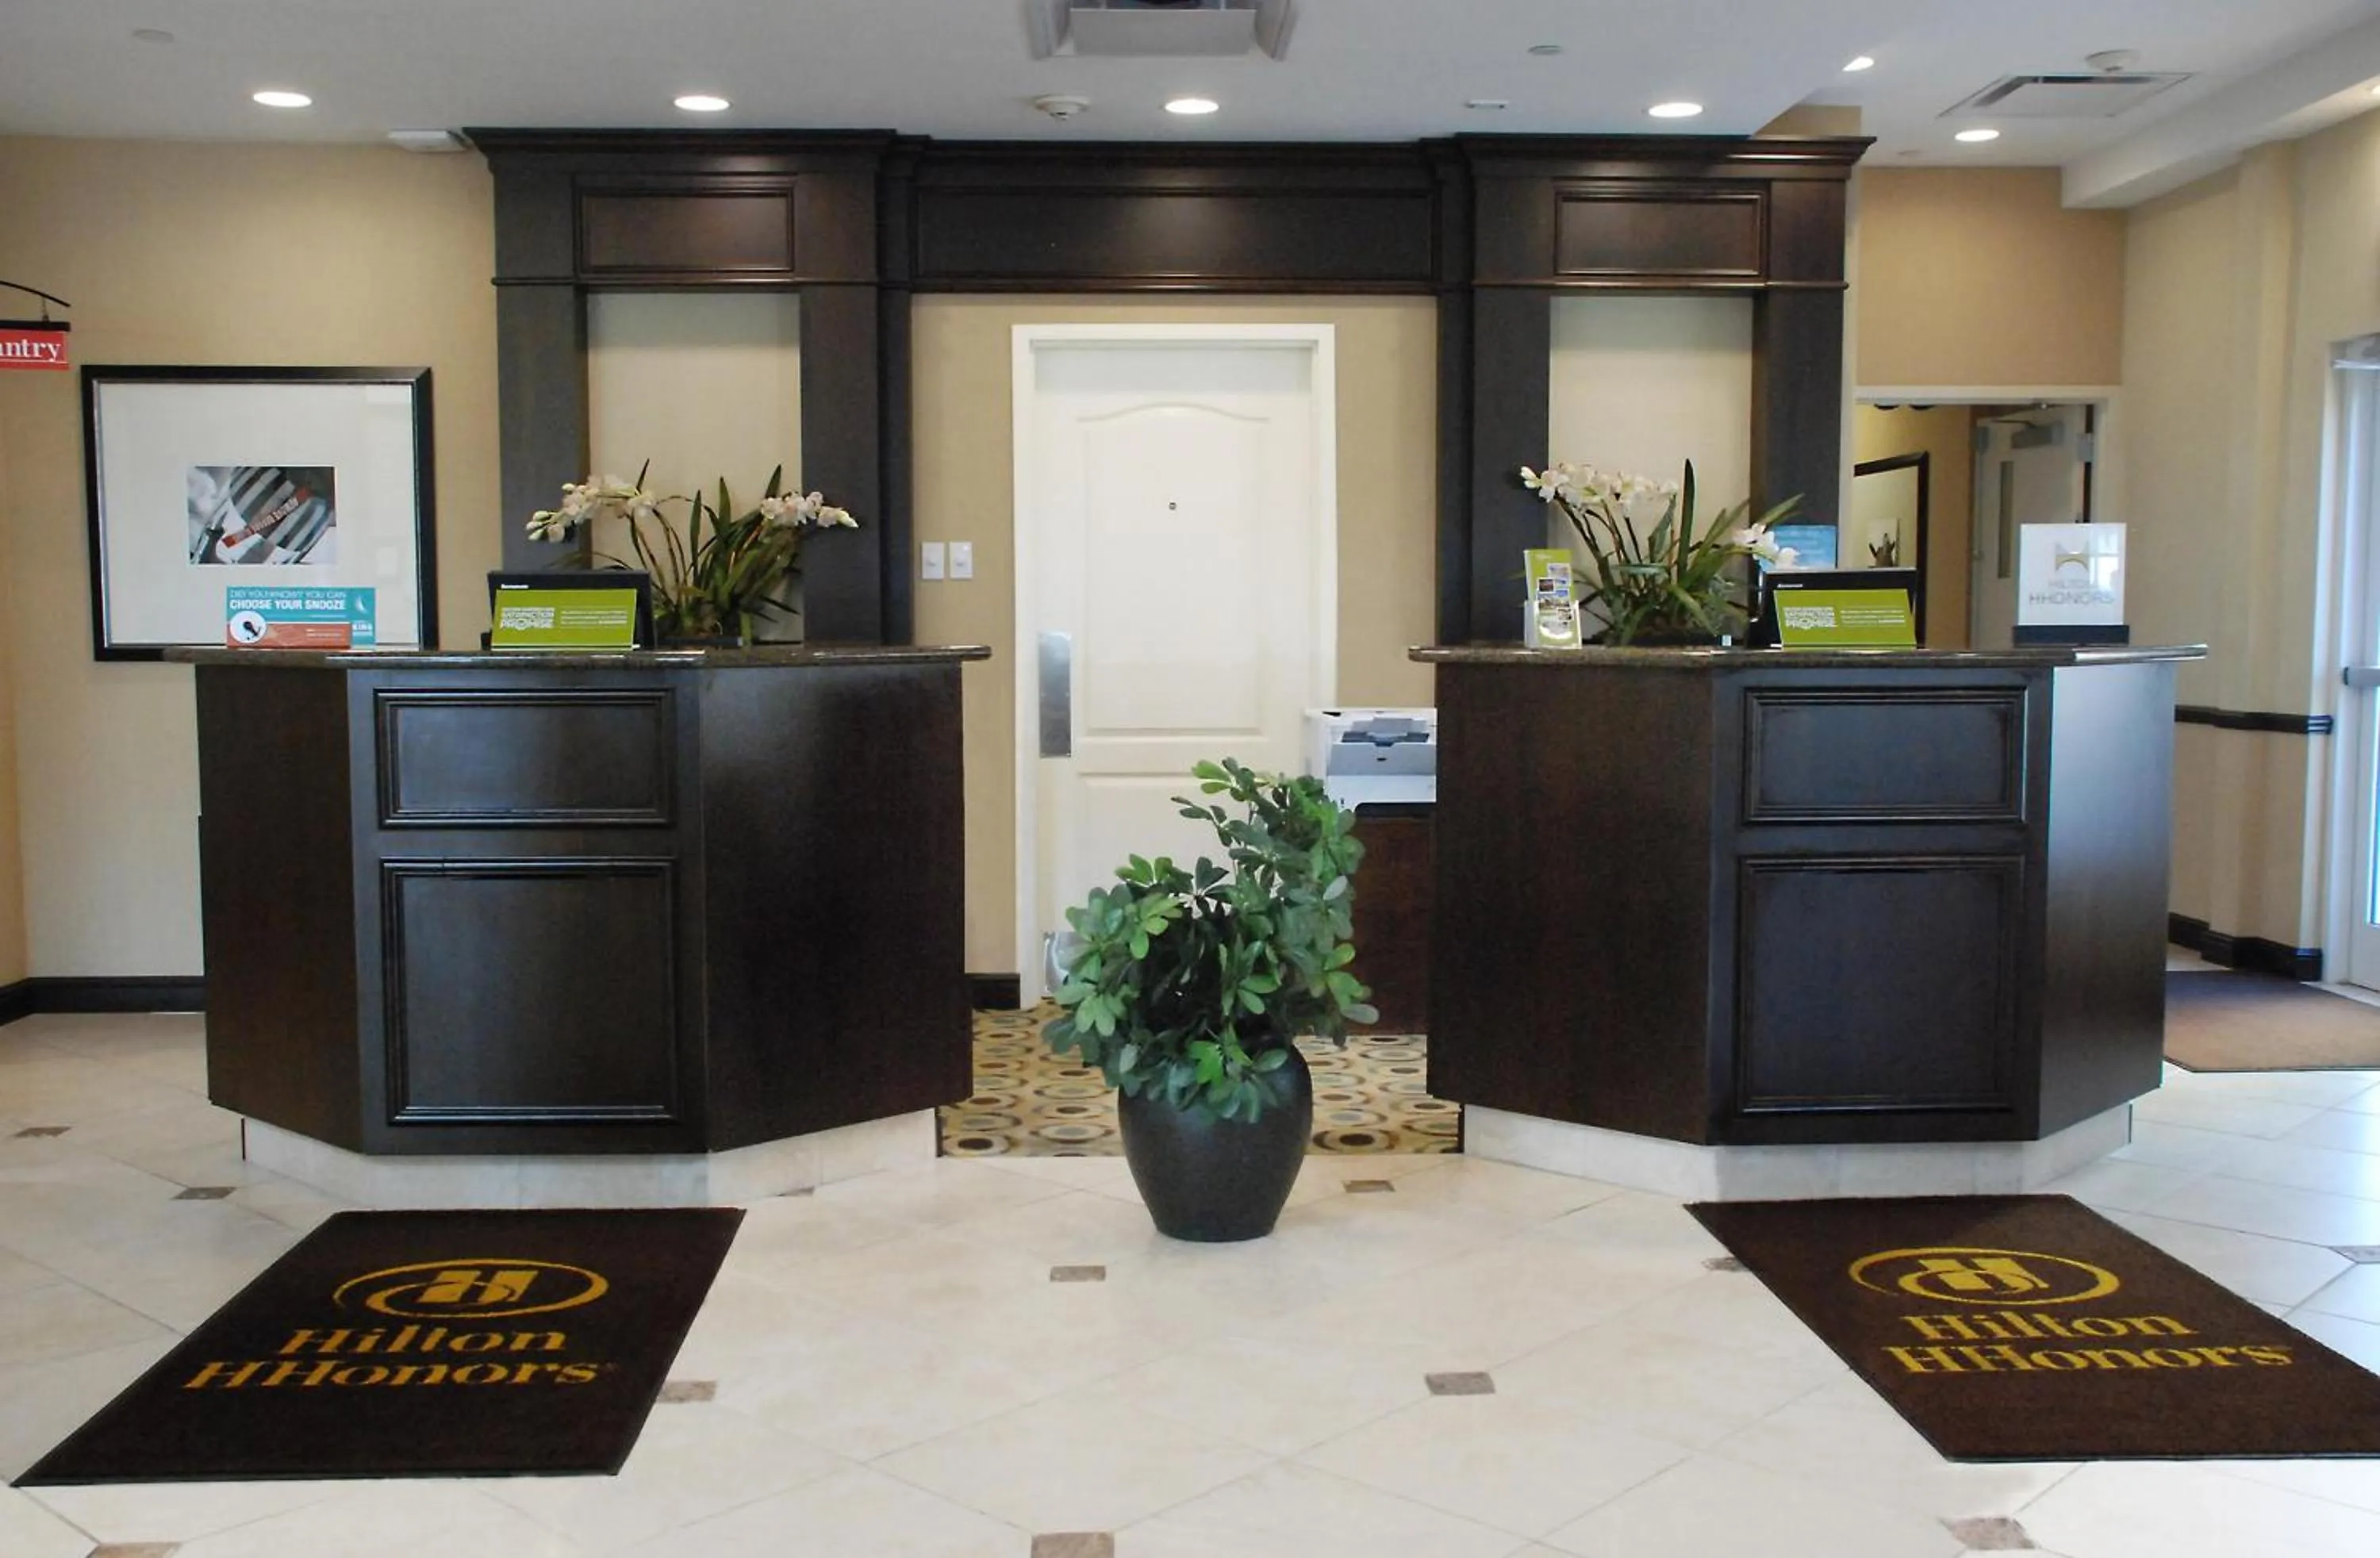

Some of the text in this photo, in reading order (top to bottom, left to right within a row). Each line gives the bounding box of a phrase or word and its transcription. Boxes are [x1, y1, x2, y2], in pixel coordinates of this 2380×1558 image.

[229, 599, 347, 610] CHOOSE YOUR SNOOZE
[278, 1324, 566, 1355] Hilton
[1902, 1310, 2200, 1341] Hilton
[1880, 1344, 2294, 1373] HHonors
[182, 1360, 599, 1389] HHonors
